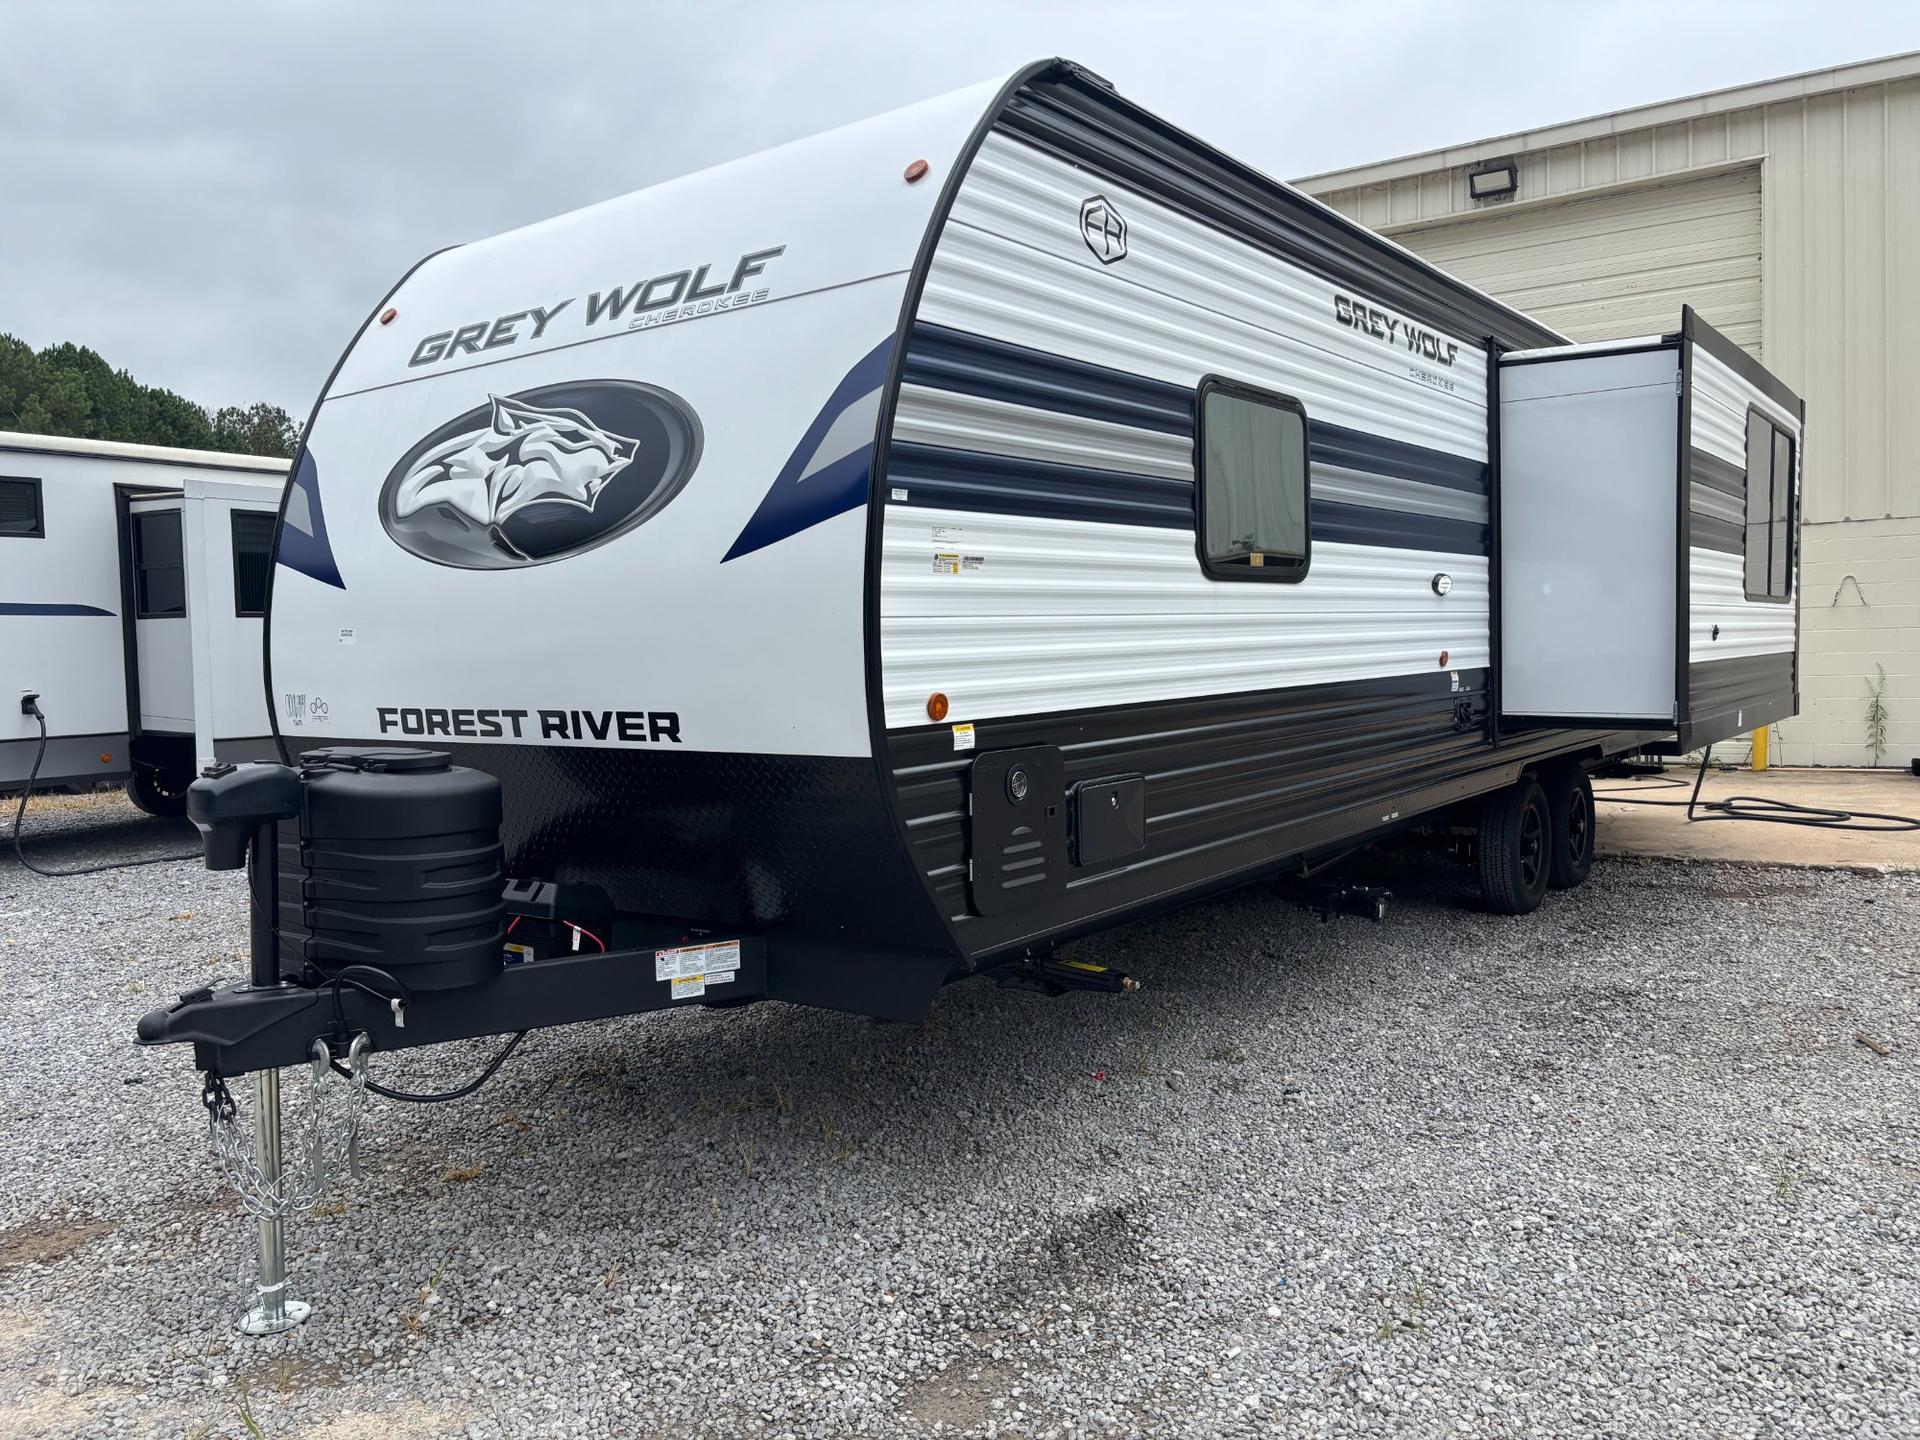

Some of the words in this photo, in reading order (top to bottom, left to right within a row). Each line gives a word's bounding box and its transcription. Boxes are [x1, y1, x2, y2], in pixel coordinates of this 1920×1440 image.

[408, 297, 576, 368] GREY
[585, 244, 786, 326] WOLF
[628, 288, 769, 329] CHEROKEE
[1334, 293, 1400, 344] GREY
[1403, 322, 1458, 368] WOLF
[376, 707, 528, 738] FOREST
[537, 709, 683, 743] RIVER
